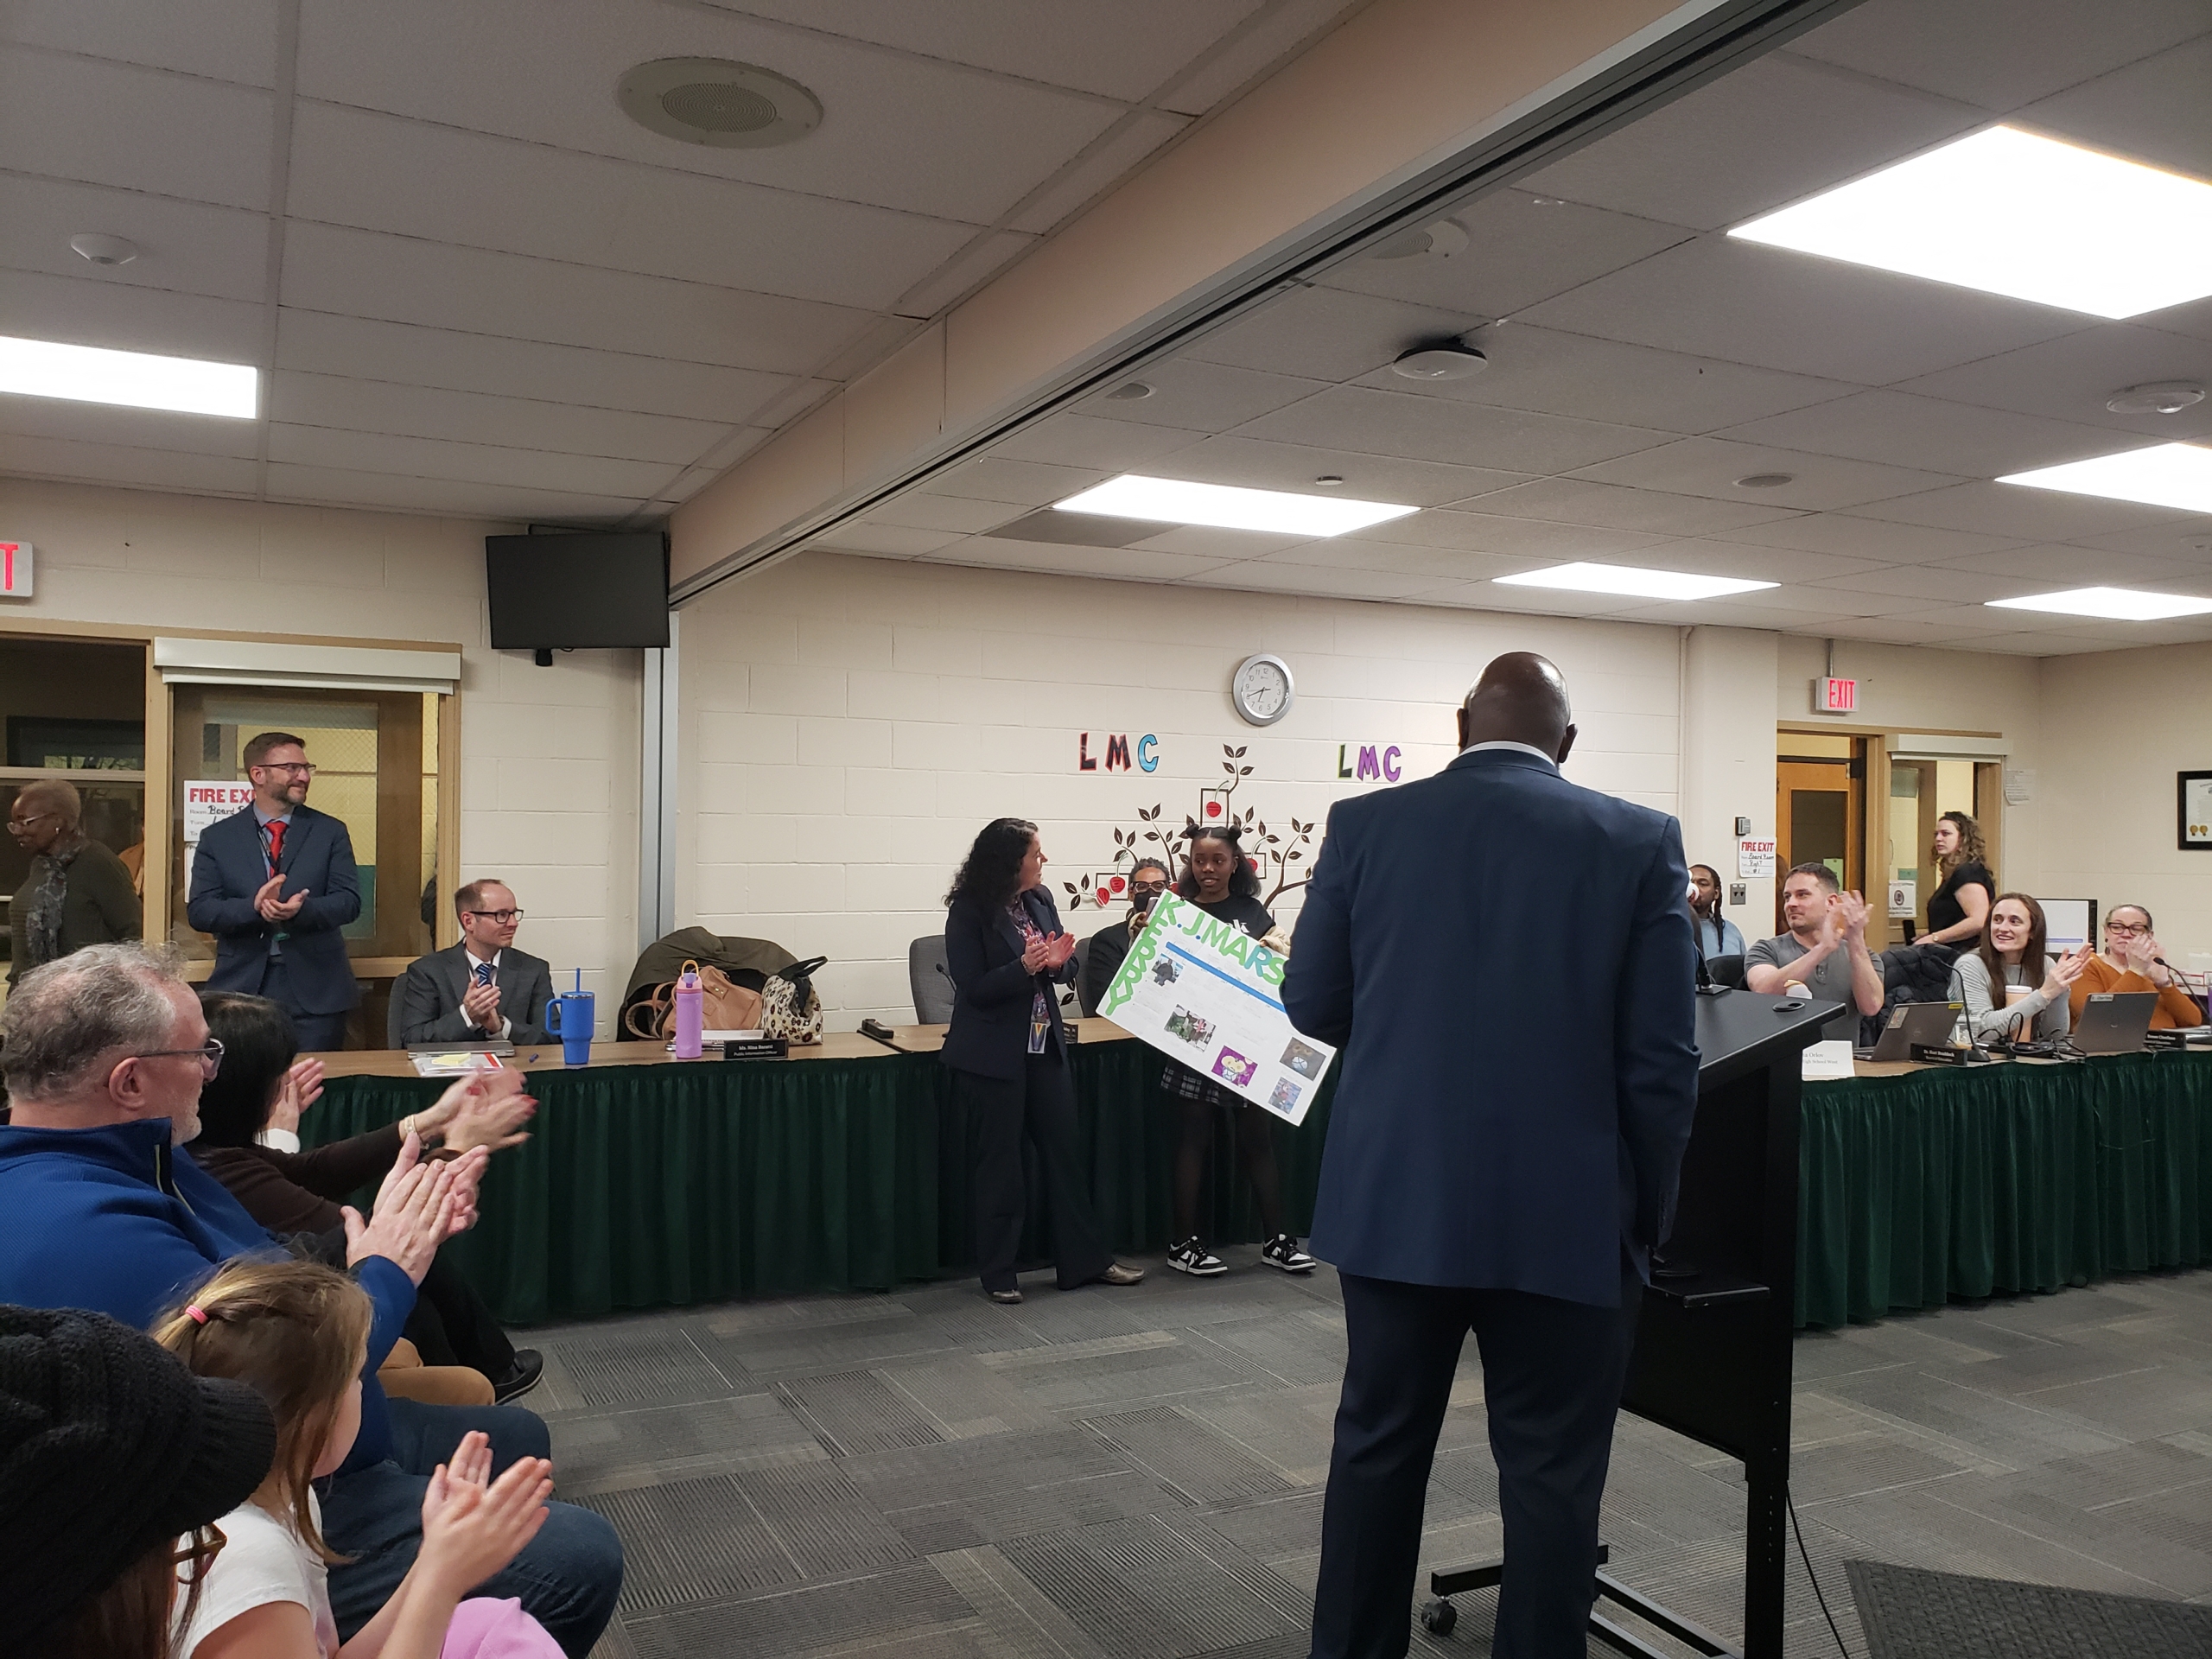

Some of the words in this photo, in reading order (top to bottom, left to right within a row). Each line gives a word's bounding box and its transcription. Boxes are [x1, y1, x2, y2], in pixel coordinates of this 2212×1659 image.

[1829, 679, 1855, 709] EXIT
[1079, 732, 1160, 772] LMC
[1338, 743, 1402, 783] LMC
[190, 788, 226, 803] FIRE
[230, 789, 256, 804] EXI
[207, 805, 235, 815] Board
[1741, 842, 1757, 852] FIRE
[1758, 842, 1775, 852] EXIT
